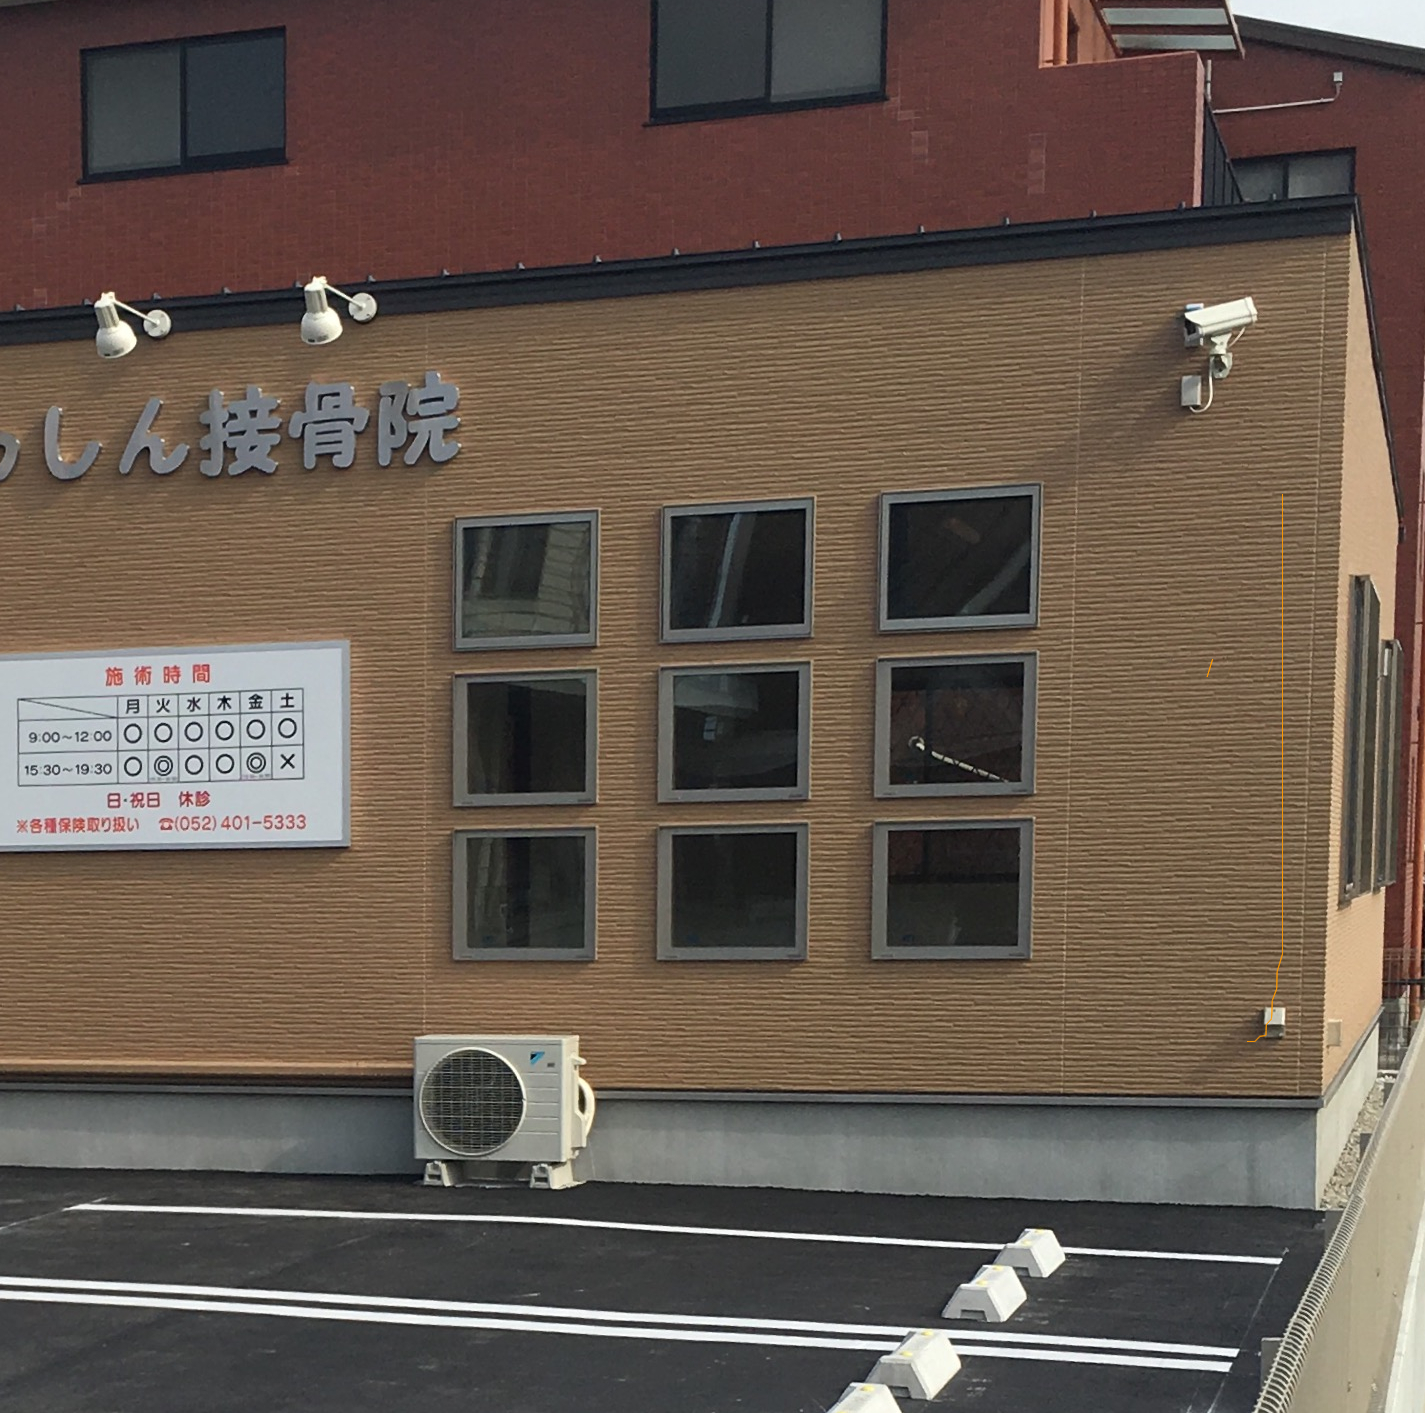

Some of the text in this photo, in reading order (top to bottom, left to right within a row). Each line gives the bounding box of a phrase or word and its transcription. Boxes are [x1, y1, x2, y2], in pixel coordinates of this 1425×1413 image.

[105, 664, 212, 686] 施術時間
[125, 694, 295, 714] 月 火 水 木 金 土
[179, 791, 211, 807] 休診
